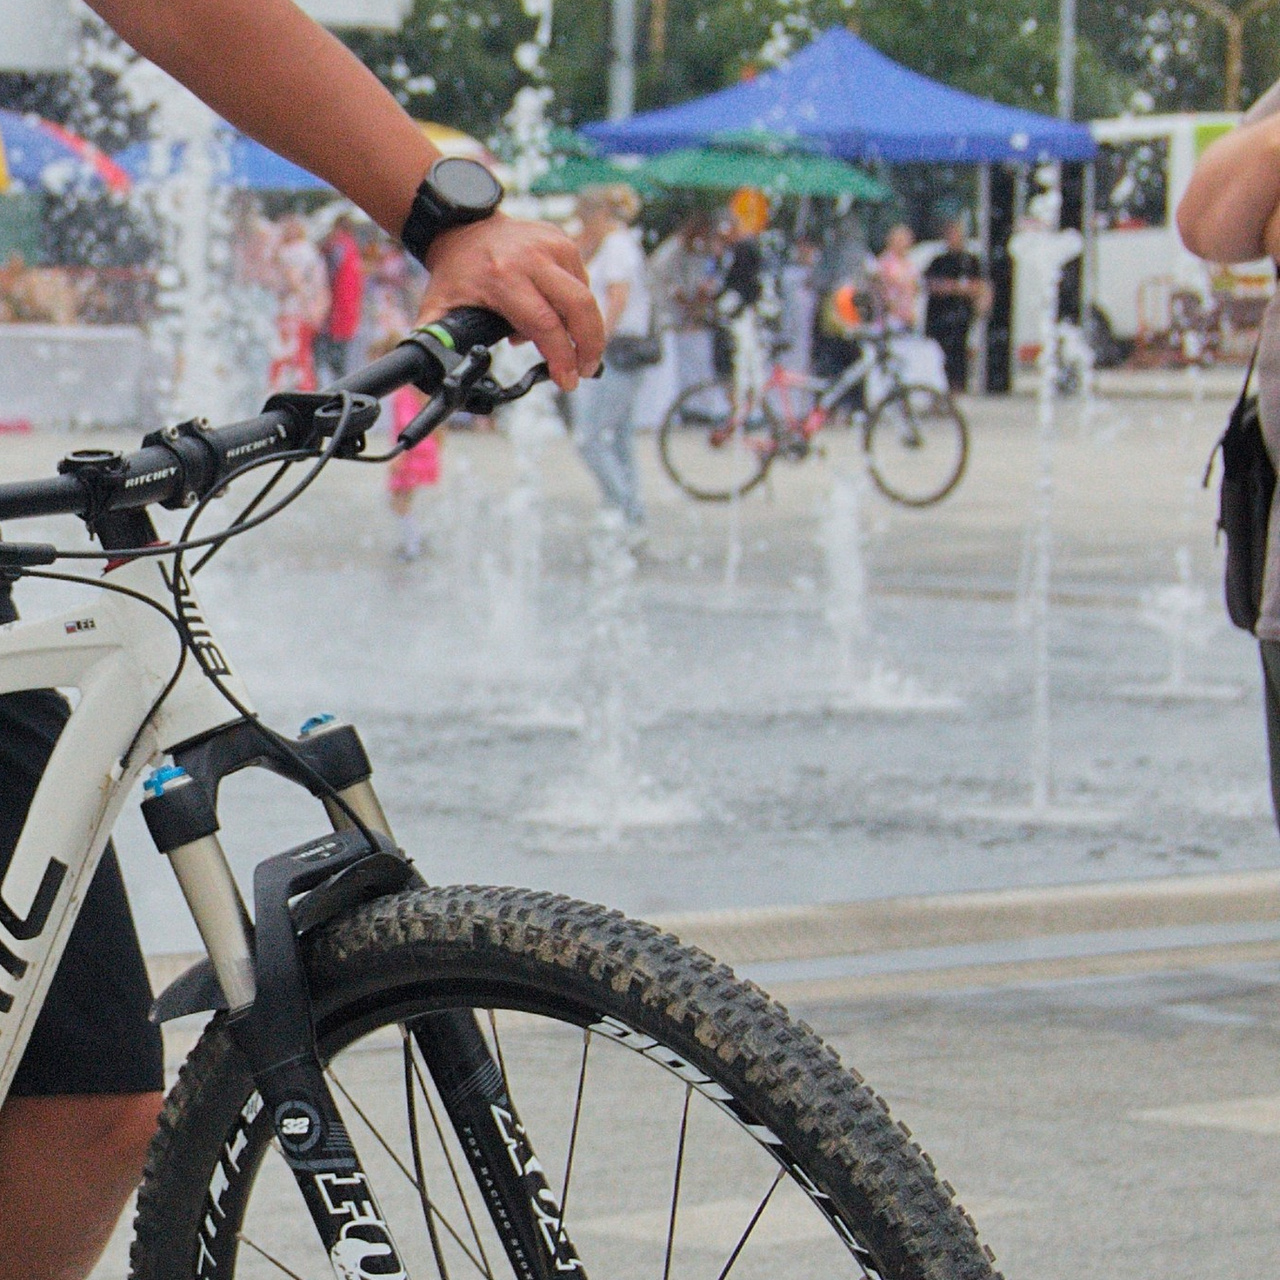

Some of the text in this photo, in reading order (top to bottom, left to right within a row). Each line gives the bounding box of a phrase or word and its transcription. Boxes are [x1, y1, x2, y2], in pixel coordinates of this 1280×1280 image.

[226, 436, 278, 458] RITCHEY
[125, 466, 178, 488] RITCHEY
[282, 1116, 310, 1135] 32
